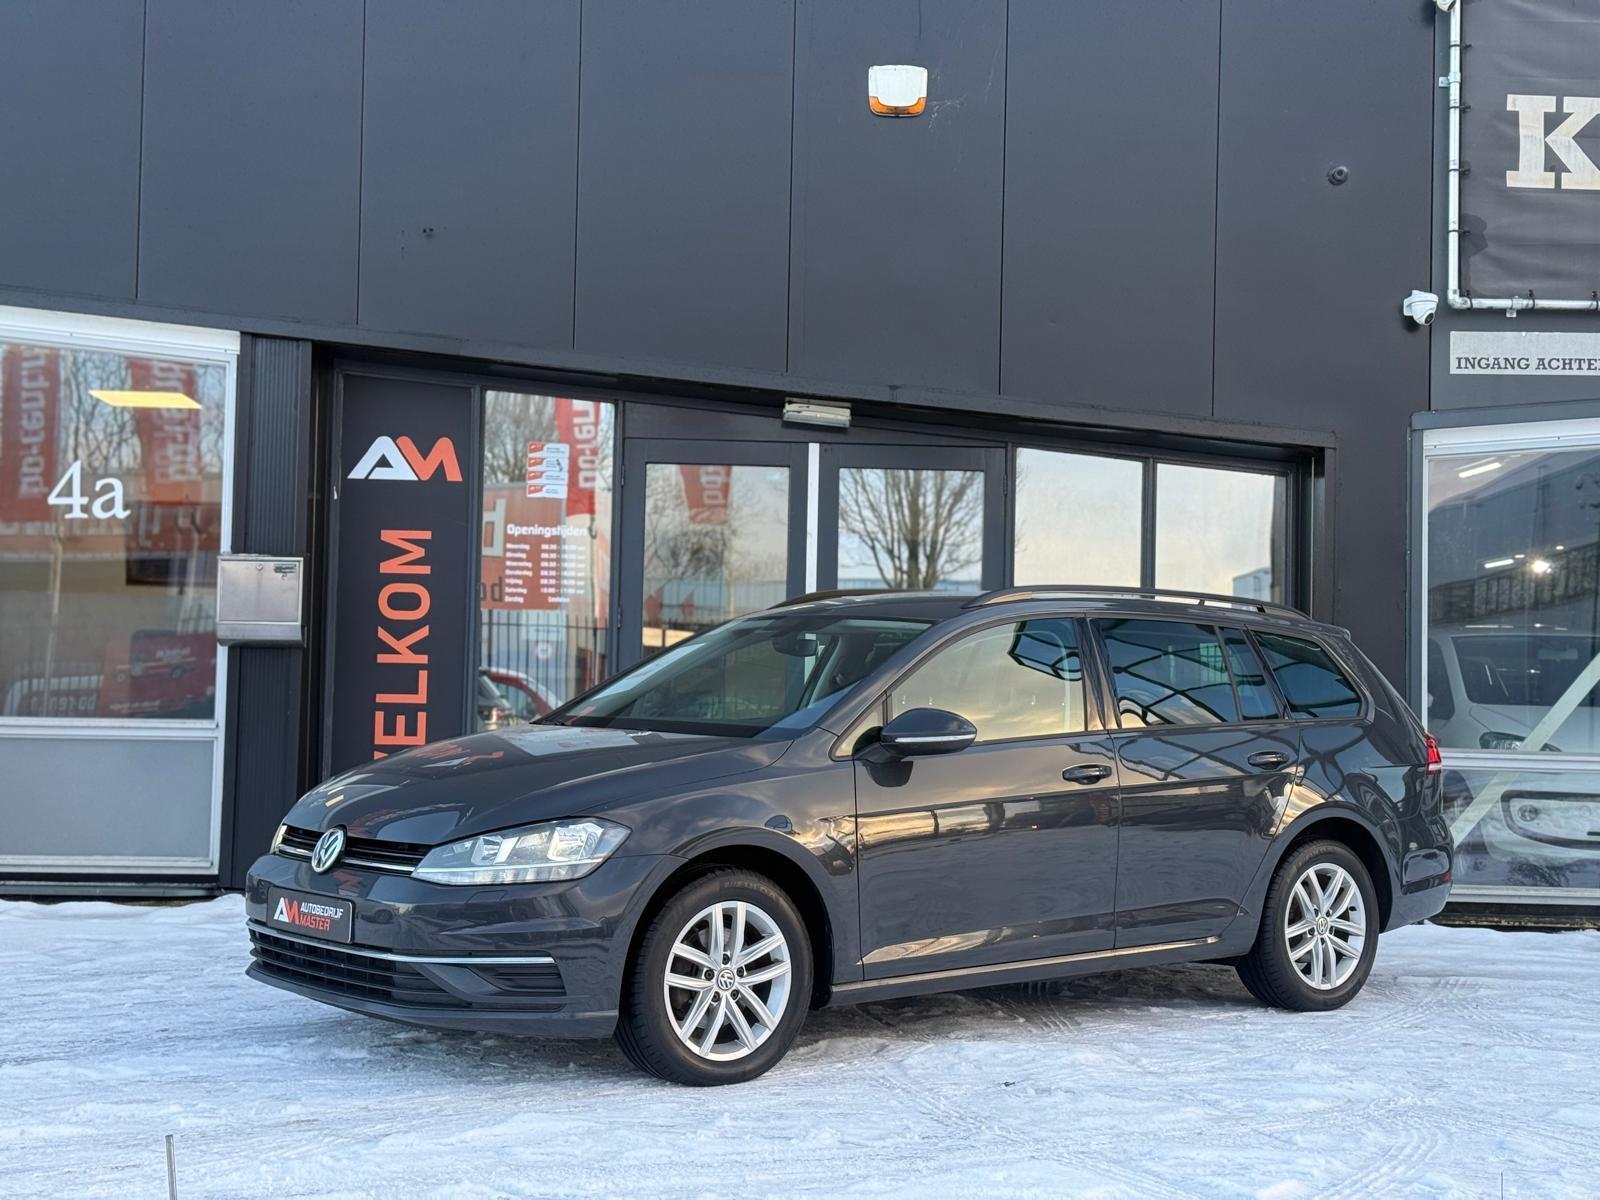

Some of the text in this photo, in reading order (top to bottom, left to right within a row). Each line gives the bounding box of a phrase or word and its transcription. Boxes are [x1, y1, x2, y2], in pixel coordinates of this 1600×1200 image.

[1456, 357, 1600, 371] INGANG ACHTE
[47, 459, 131, 520] 4a
[507, 524, 587, 538] Openingstijden
[373, 529, 432, 760] ELKOM
[300, 902, 344, 919] AUTOBEDRIJF
[300, 913, 330, 931] MASTER
